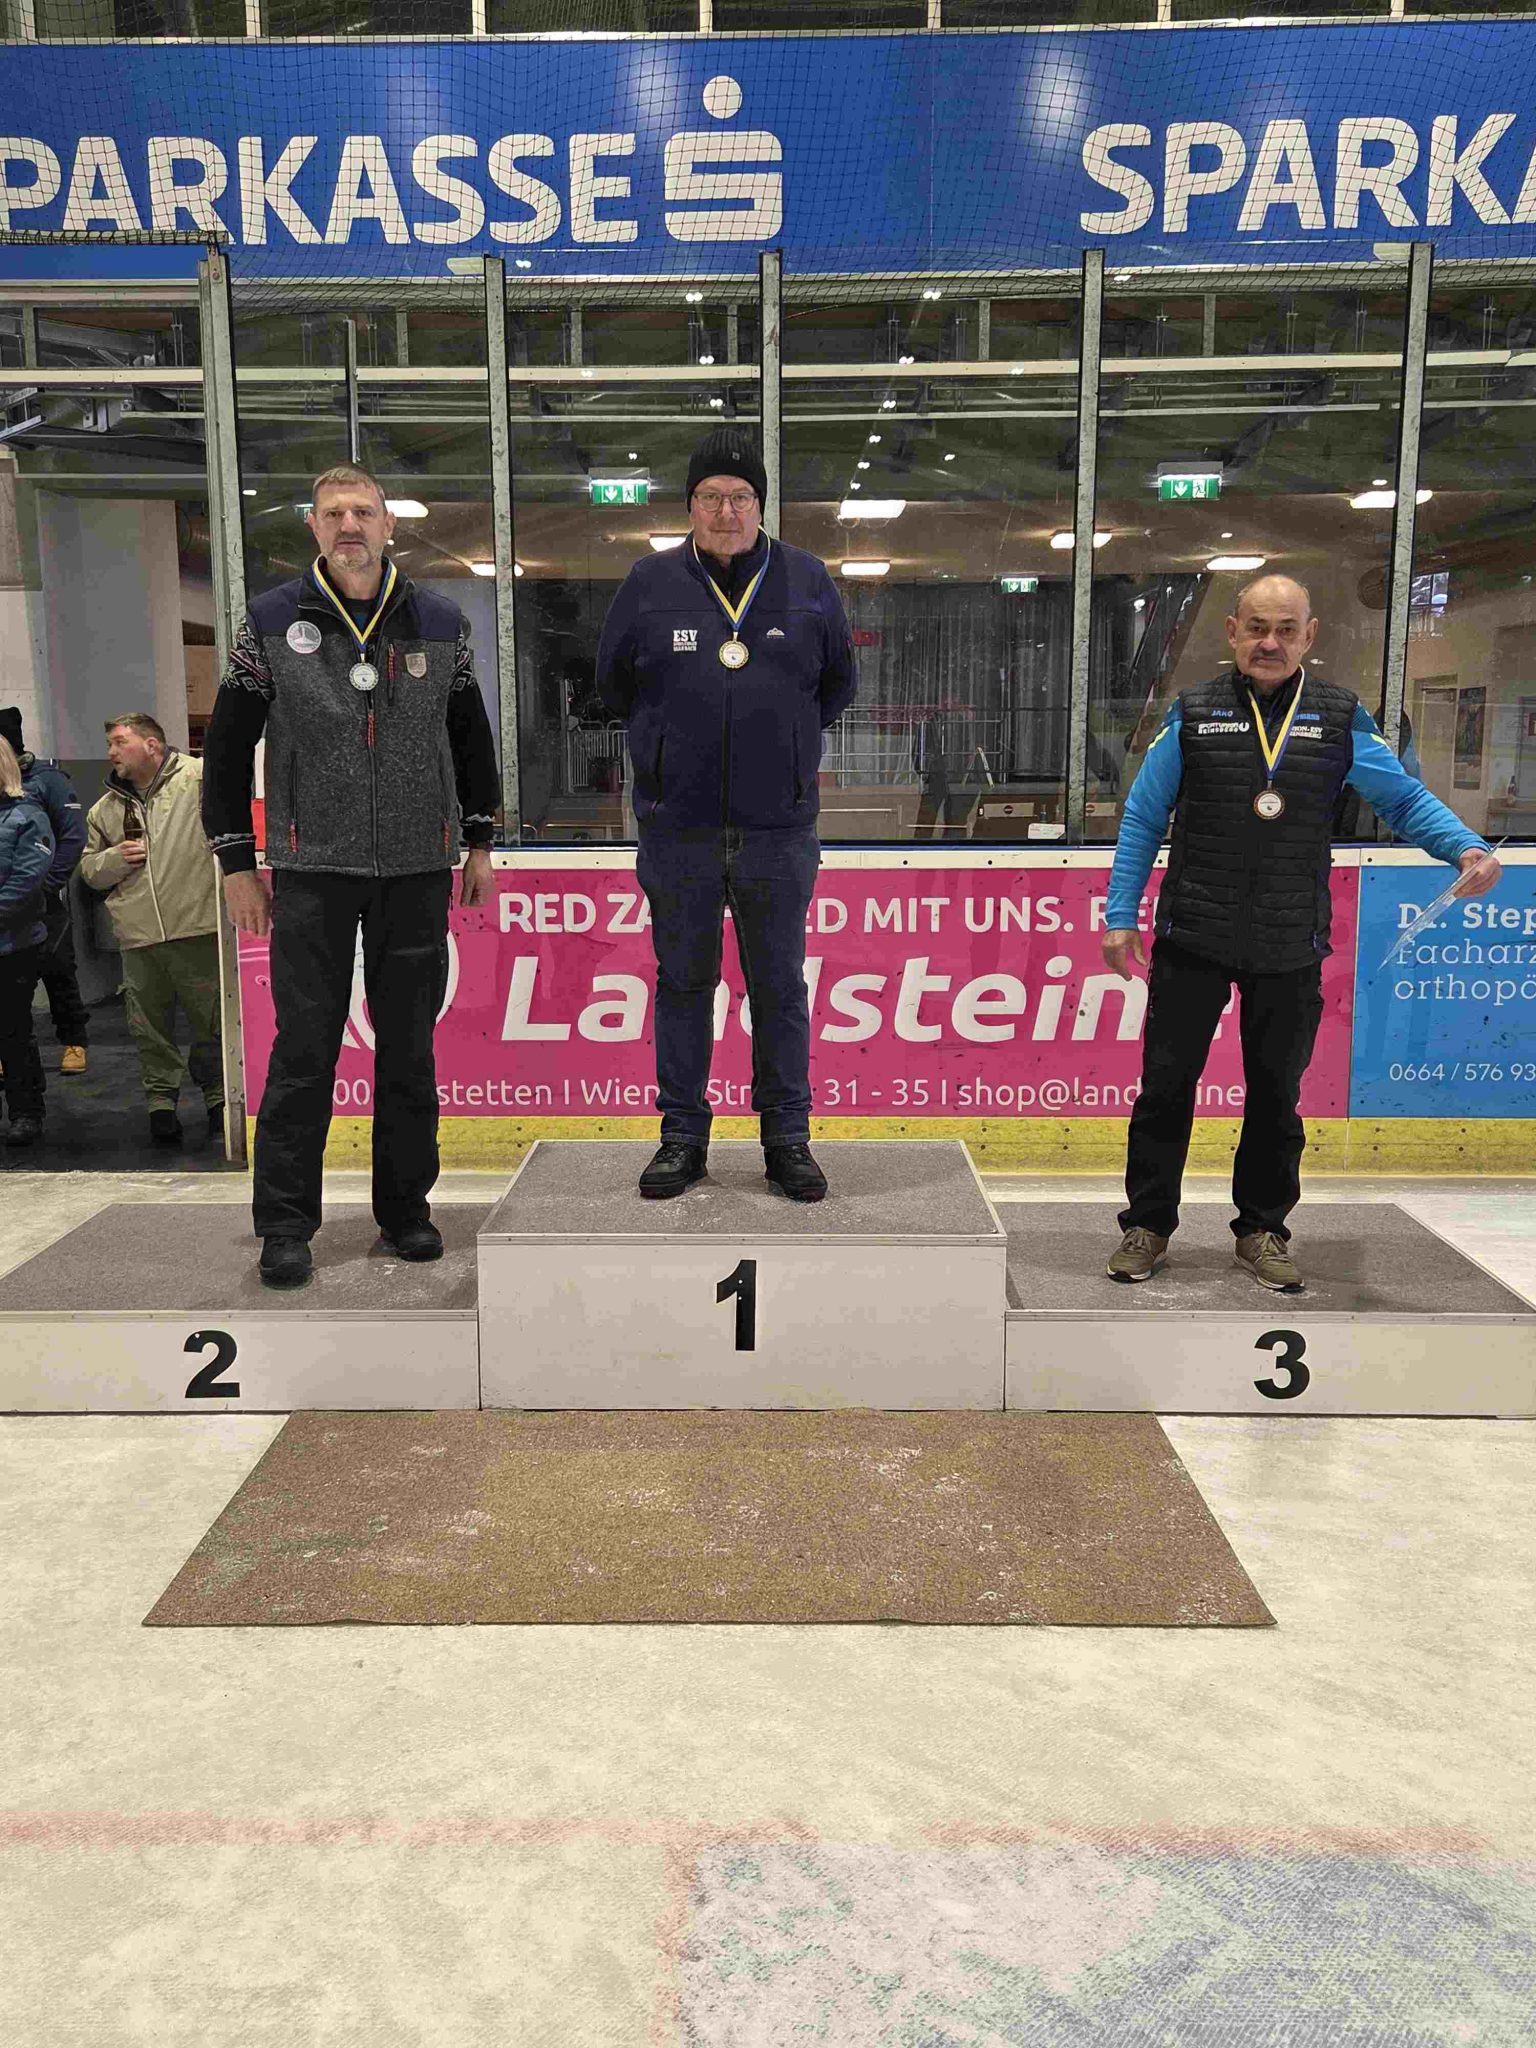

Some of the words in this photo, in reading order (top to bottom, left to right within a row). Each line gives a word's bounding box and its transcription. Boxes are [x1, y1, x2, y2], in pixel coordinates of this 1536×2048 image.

[1080, 112, 1536, 236] SPARK
[672, 629, 698, 642] ESV
[499, 893, 597, 933] RED
[863, 897, 950, 932] MIT
[964, 896, 1074, 932] UNS.
[437, 1078, 552, 1106] stetten
[823, 1078, 858, 1106] 31
[891, 1078, 930, 1106] 35
[1389, 1063, 1446, 1081] 0664
[1464, 1063, 1504, 1081] 576
[1510, 1063, 1536, 1082] 93
[716, 1259, 757, 1351] 1
[183, 1330, 240, 1399] 2
[1253, 1329, 1310, 1400] 3
